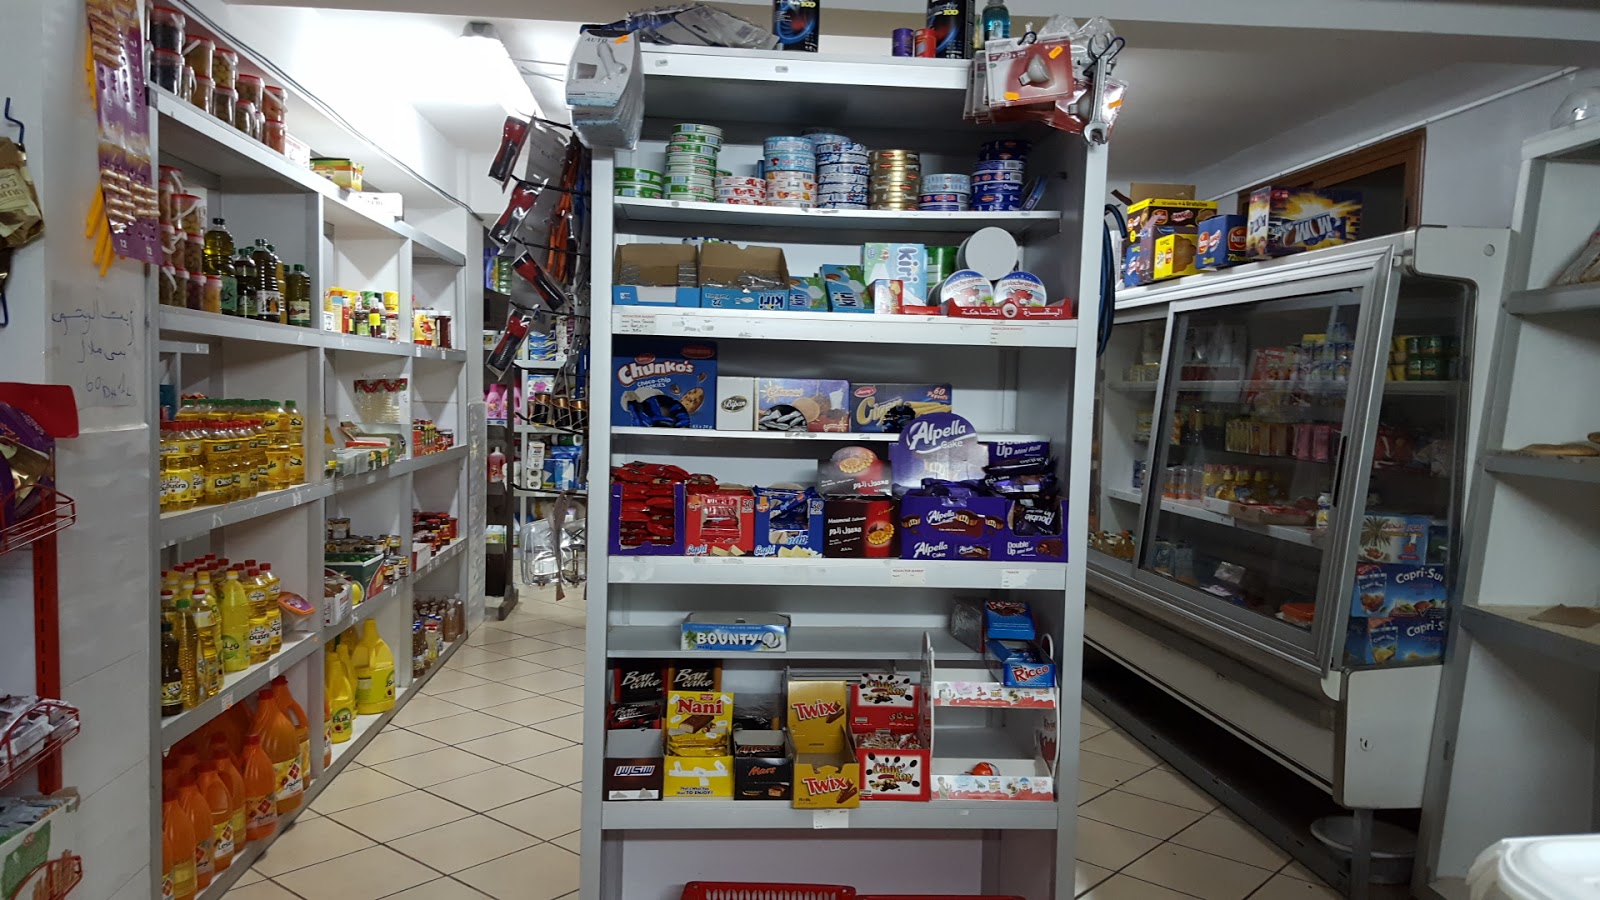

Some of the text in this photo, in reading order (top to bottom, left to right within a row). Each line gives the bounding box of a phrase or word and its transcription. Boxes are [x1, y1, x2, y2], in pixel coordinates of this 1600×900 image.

[585, 36, 608, 44] AUTO
[897, 246, 920, 284] kiri
[759, 294, 784, 310] kiri
[933, 386, 946, 396] 60
[909, 419, 967, 451] Alpella
[940, 439, 964, 449] Cake
[996, 445, 1013, 458] Up
[913, 541, 949, 558] Alpella
[1007, 540, 1030, 549] Double
[1007, 547, 1016, 556] Up
[696, 631, 762, 646] BOUNTY
[1013, 664, 1050, 682] Ricco
[677, 698, 725, 716] Nani
[748, 766, 777, 777] Mars
